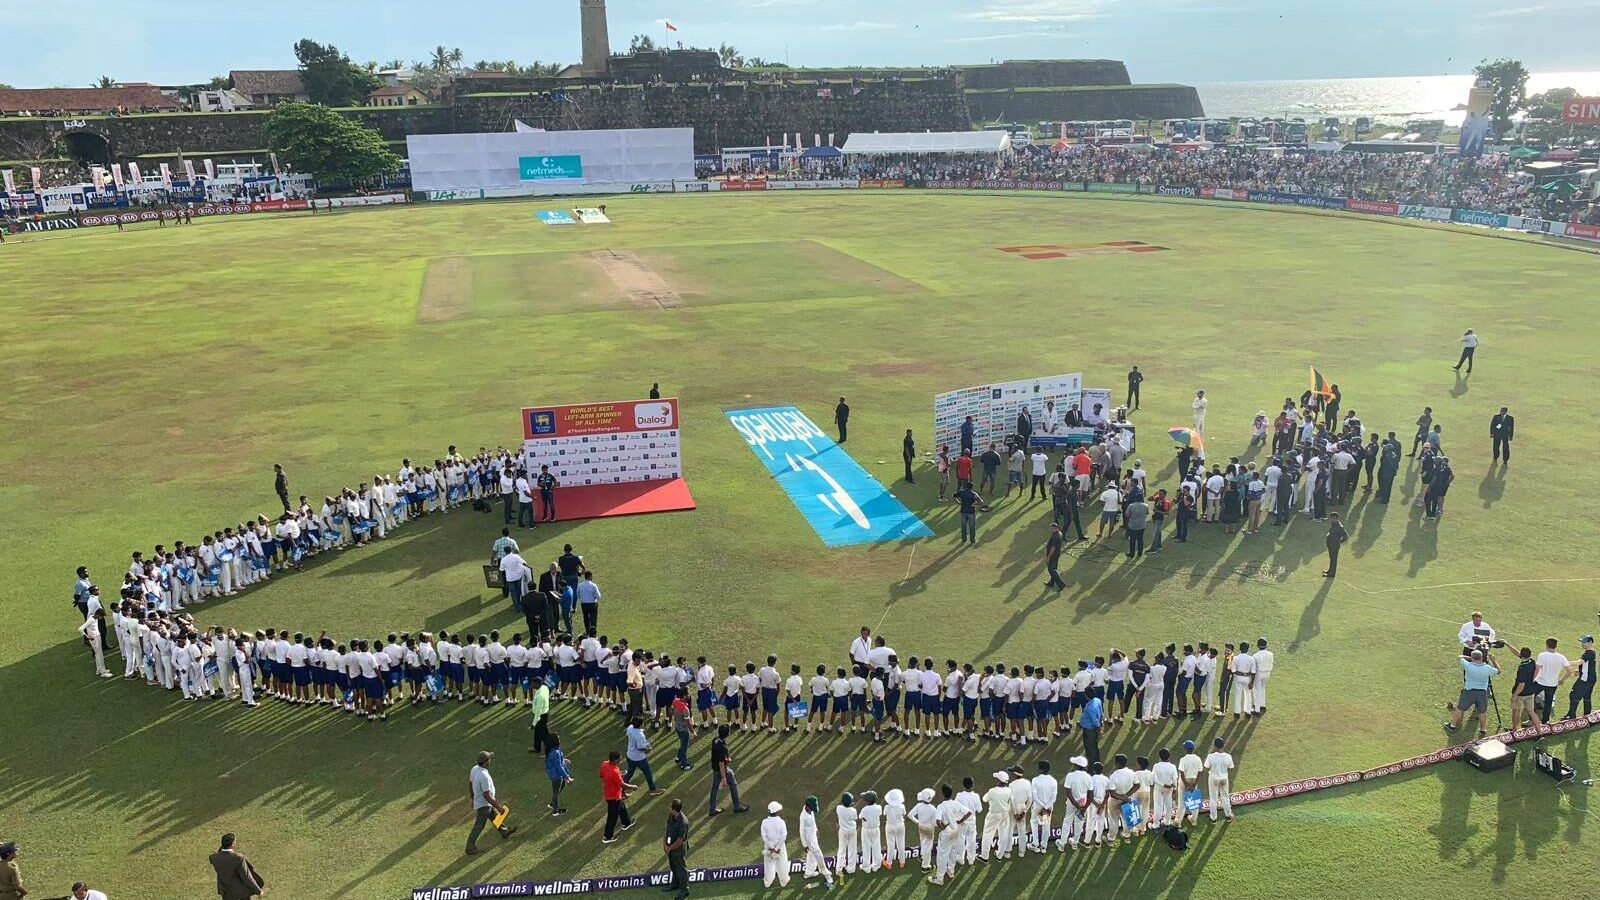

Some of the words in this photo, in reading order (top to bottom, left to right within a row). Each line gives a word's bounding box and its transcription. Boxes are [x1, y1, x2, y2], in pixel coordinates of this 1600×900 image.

[1159, 186, 1196, 197] SmartPA
[25, 221, 43, 232] JM
[46, 218, 78, 230] FINN
[1460, 212, 1500, 226] netmeds
[638, 416, 667, 425] Dialog
[479, 884, 527, 895] vitamins
[534, 880, 590, 896] wellman
[598, 877, 645, 889] vitamins
[650, 869, 705, 885] welan
[713, 867, 759, 879] vitamins
